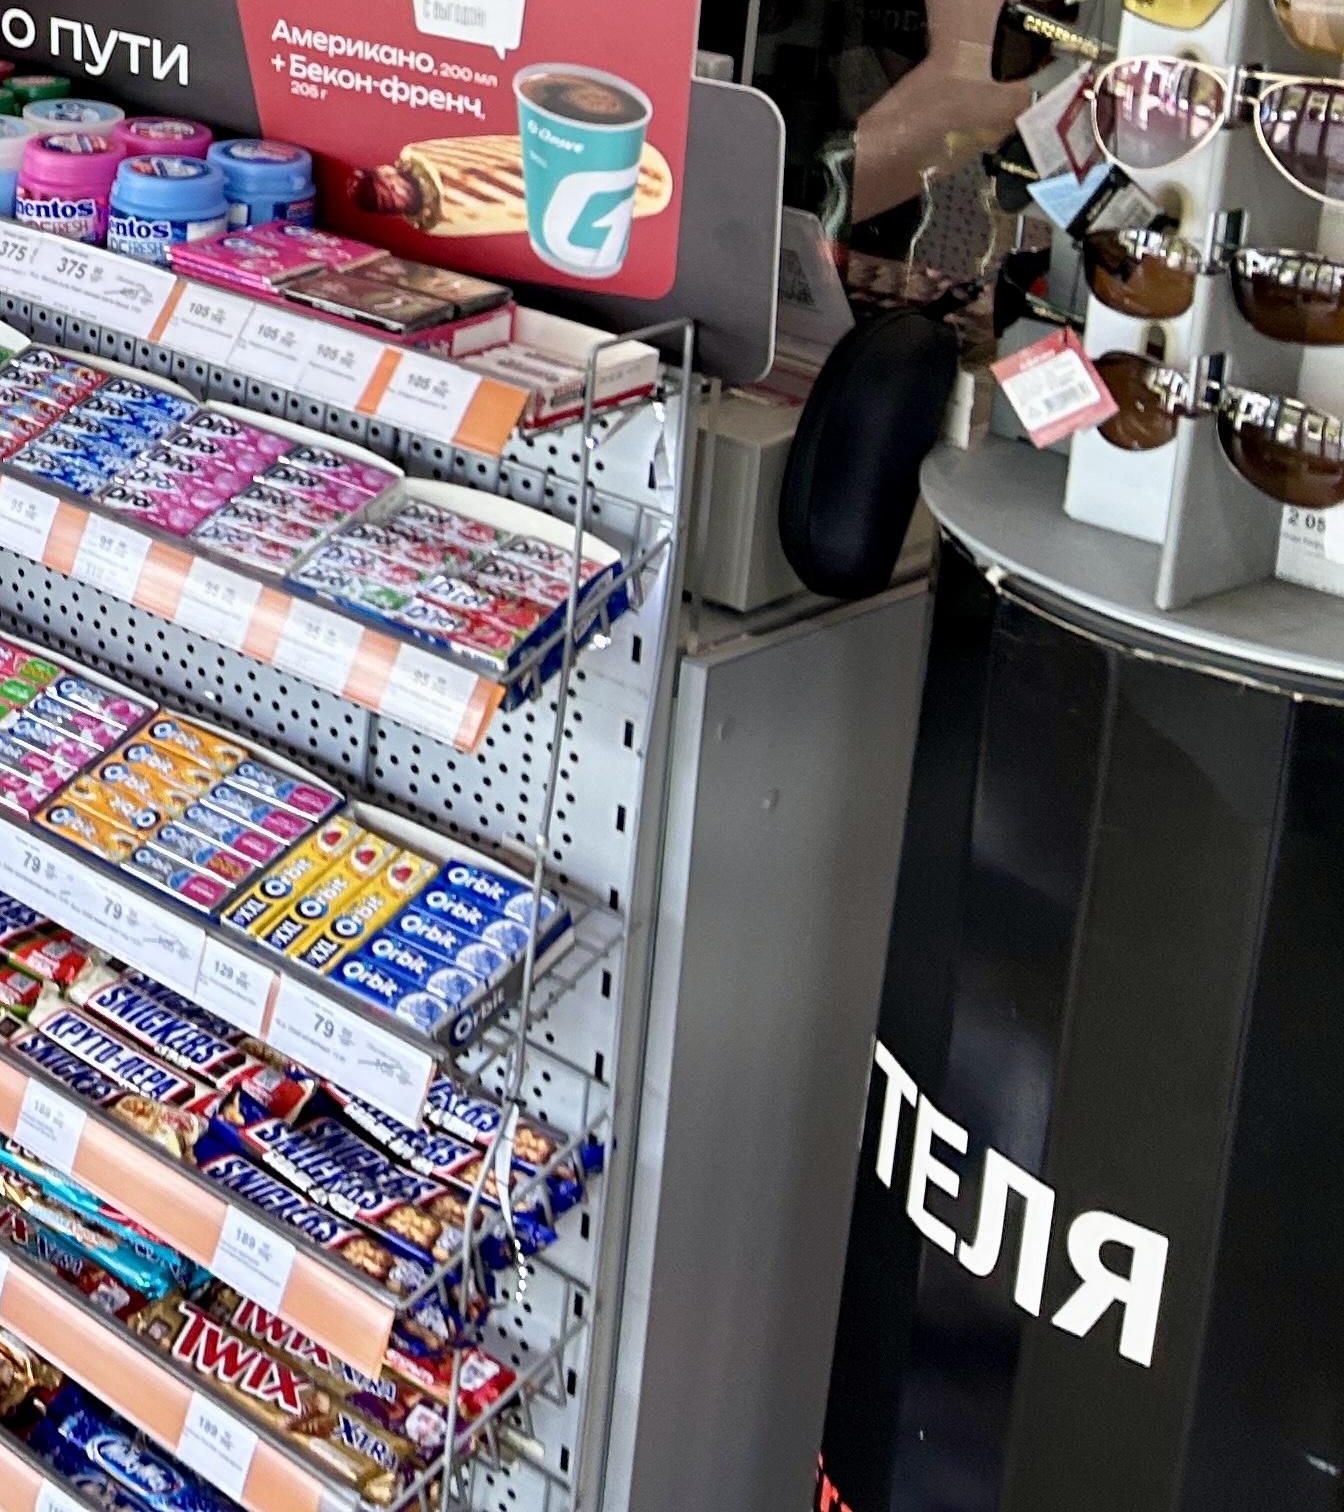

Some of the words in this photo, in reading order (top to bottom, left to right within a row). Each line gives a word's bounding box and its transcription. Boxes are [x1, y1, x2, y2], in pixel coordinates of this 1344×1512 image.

[49, 17, 190, 86] пути
[440, 62, 473, 81] 200
[108, 217, 170, 238] entos
[56, 256, 87, 280] 375
[188, 300, 210, 318] 105
[257, 323, 279, 341] 105
[22, 850, 42, 873] 79
[447, 867, 505, 901] Orbit
[103, 898, 124, 921] 79
[333, 892, 385, 937] Orbit
[425, 890, 484, 926] Orbit
[400, 914, 457, 950] Orbit
[371, 938, 428, 975] Orbit
[342, 960, 398, 998] Orbit
[96, 986, 223, 1065] SNICKERS
[314, 1012, 335, 1039] 79
[172, 1300, 310, 1416] TWIX
